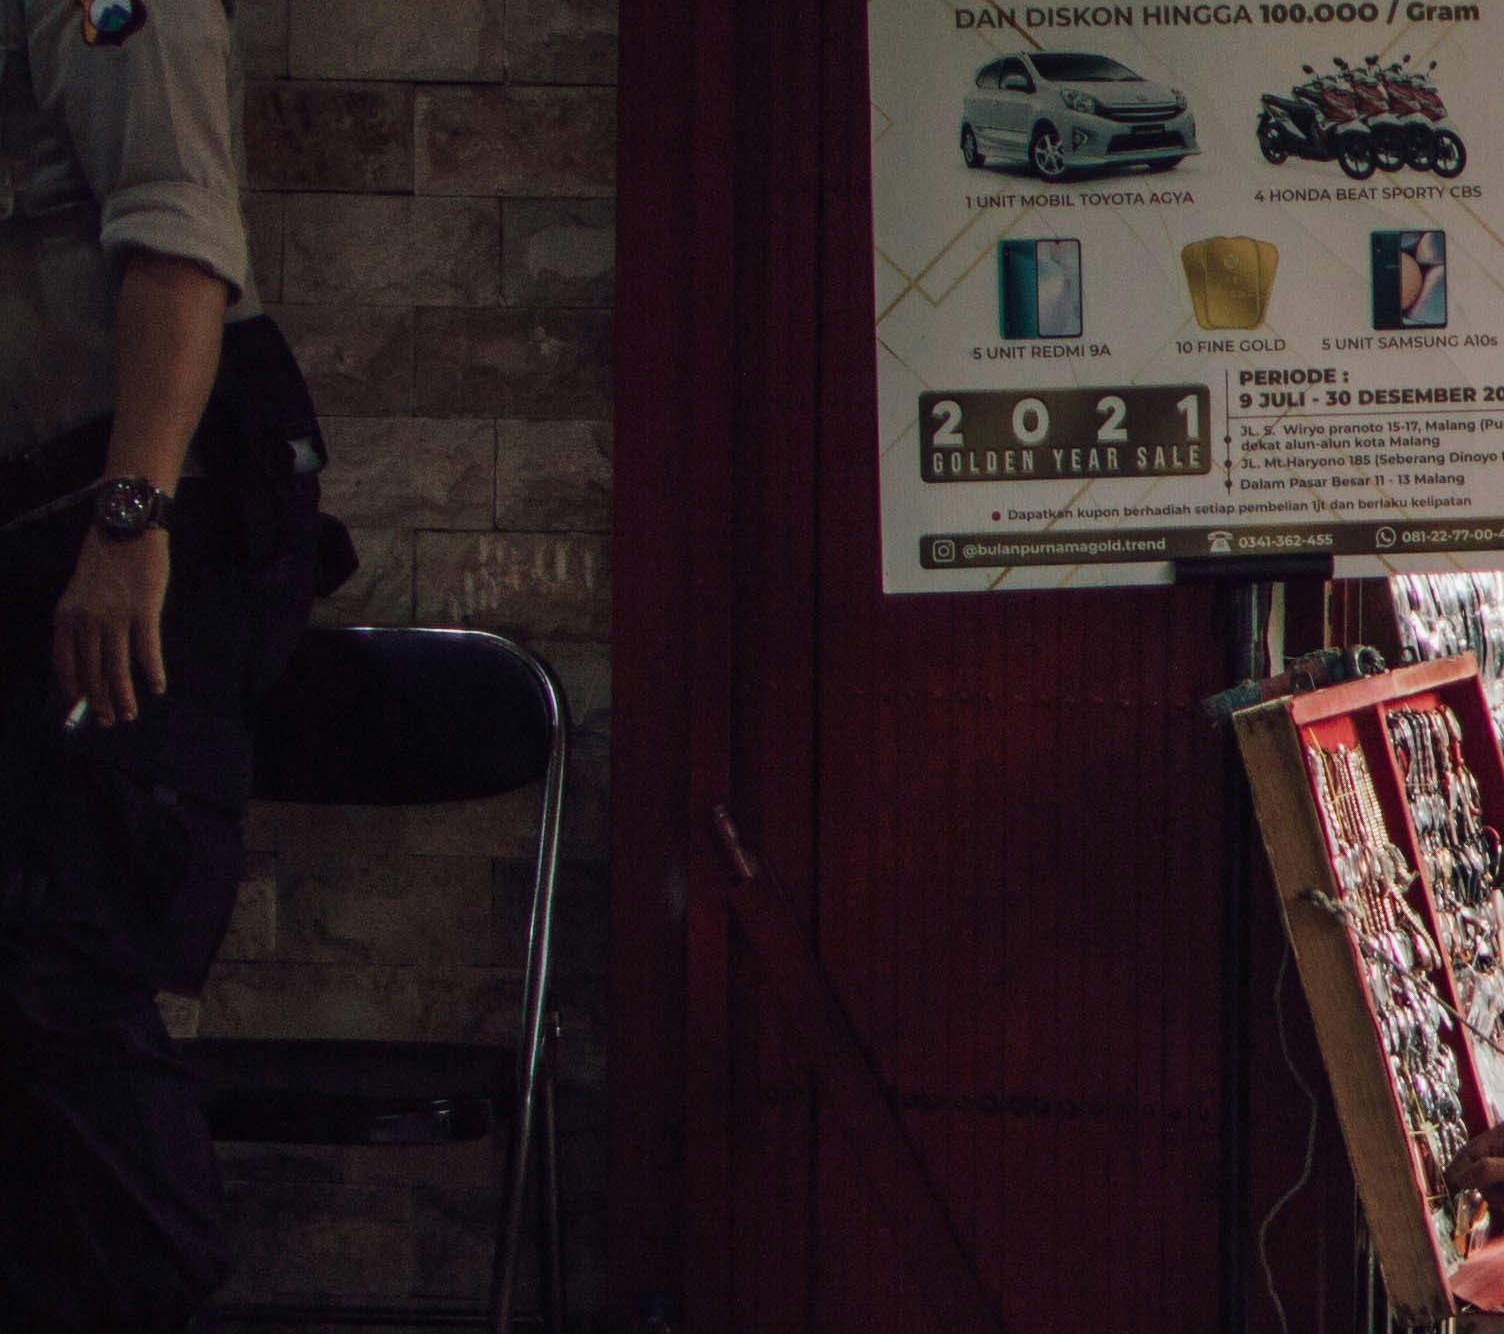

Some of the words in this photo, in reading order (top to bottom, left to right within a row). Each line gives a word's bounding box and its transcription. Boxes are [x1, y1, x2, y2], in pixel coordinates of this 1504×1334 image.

[955, 6, 1021, 30] DAN
[1026, 5, 1138, 27] DISKON
[1143, 3, 1252, 26] HINGGA
[1260, 3, 1379, 24] 100.000
[1385, 0, 1399, 24] /
[1406, 0, 1480, 22] Gram
[964, 195, 972, 209] 1
[976, 194, 1016, 208] UNIT
[1020, 195, 1075, 208] MOBIL
[1079, 192, 1146, 207] TOYOTA
[1149, 190, 1196, 205] AGYA
[1254, 189, 1265, 203] 4
[1270, 189, 1330, 203] HONDA
[1335, 187, 1378, 202] BEAT
[1382, 186, 1446, 201] SPORTY
[1450, 185, 1483, 200] CBS
[972, 347, 982, 360] 5
[986, 346, 1027, 360] UNIT
[1031, 344, 1085, 359] REDMI
[1089, 343, 1111, 357] 9A
[1176, 340, 1193, 354] 10
[1197, 339, 1234, 354] FINE
[1238, 338, 1287, 353] GOLD
[1321, 337, 1331, 351] 5
[1336, 336, 1374, 351] UNIT
[1377, 334, 1459, 350] SAMSUNG
[1464, 334, 1498, 349] A10s
[1239, 368, 1336, 385] PERIODE
[1240, 393, 1252, 408] 9
[1259, 392, 1305, 408] JULI
[1326, 391, 1351, 406] 30
[1359, 388, 1476, 405] DESEMBER
[932, 394, 1200, 448] 2021
[1241, 427, 1260, 436] JL.
[1284, 424, 1324, 437] Wiryo
[1329, 423, 1383, 435] pranoto
[1387, 422, 1422, 434] 15-17,
[1426, 420, 1476, 433] Malang
[1241, 439, 1281, 451] dekat
[1285, 438, 1350, 449] alun-alun
[1355, 437, 1385, 448] kota
[1389, 435, 1440, 448] Malang
[933, 449, 1034, 474] GOLDEN
[1053, 447, 1119, 471] YEAR
[1138, 445, 1201, 468] SALE
[1241, 459, 1260, 469] JL.
[1265, 456, 1345, 470] Mt.Haryono
[1349, 455, 1371, 465] 185
[1375, 454, 1445, 467] (Seberang
[1450, 452, 1497, 464] Dinoyo
[1241, 478, 1285, 490] Dalam
[1290, 477, 1328, 488] Pasar
[1332, 476, 1370, 487] Besar
[1375, 476, 1385, 486] 11
[1398, 475, 1410, 485] 13
[1415, 473, 1464, 486] Malang
[1008, 508, 1073, 521] Dapatkan
[1077, 506, 1120, 520] kupon
[1124, 503, 1190, 516] berhadiah
[1195, 502, 1235, 516] setiap
[1239, 498, 1307, 514] pembelian
[1330, 496, 1354, 508] dan
[1358, 494, 1407, 507] berlaku
[1411, 494, 1471, 509] kelipatan
[963, 538, 1166, 558] @bulanpurnamagold.trend
[1239, 535, 1333, 548] 0341-362-455
